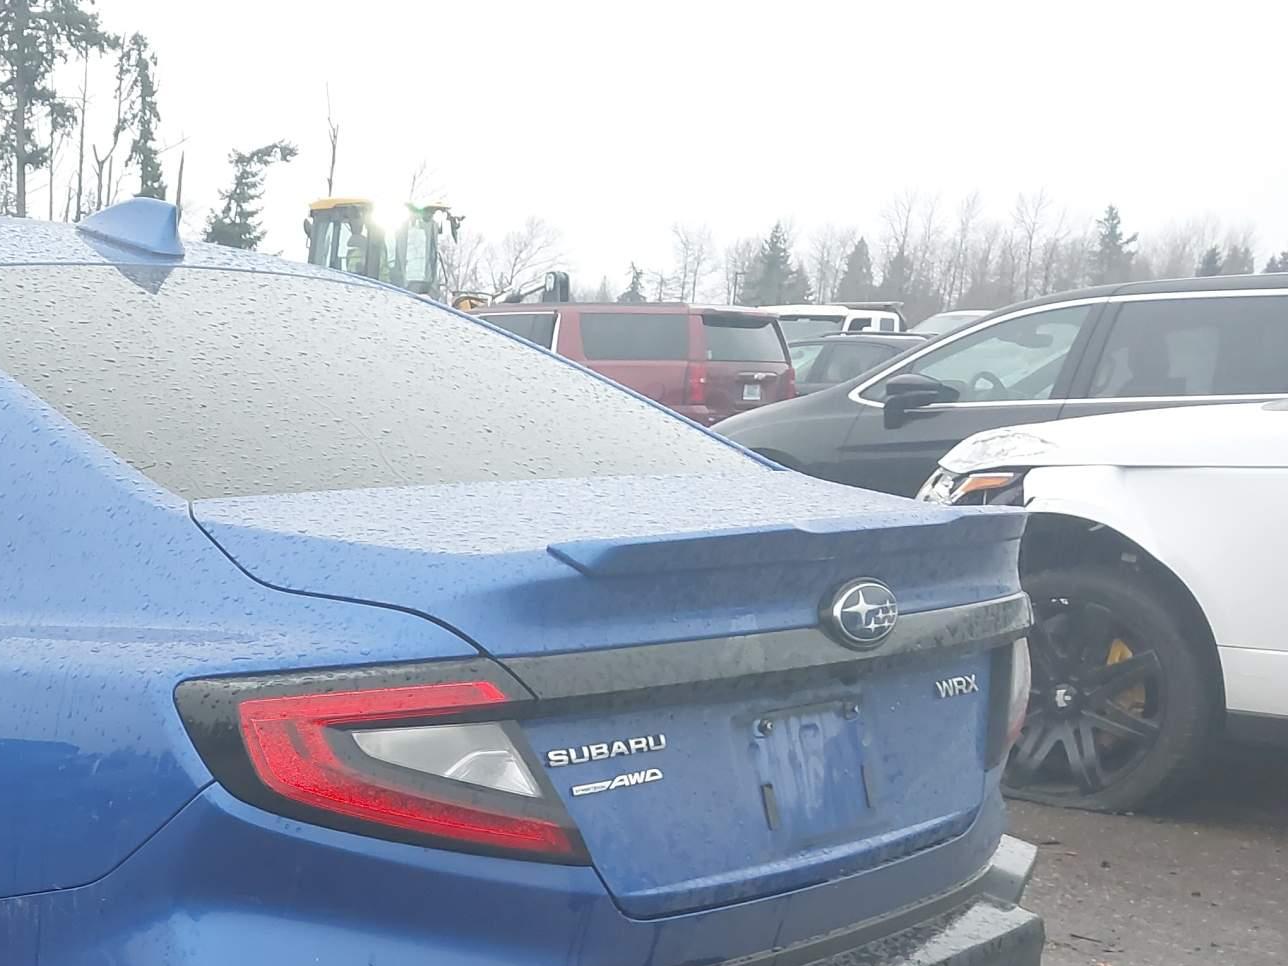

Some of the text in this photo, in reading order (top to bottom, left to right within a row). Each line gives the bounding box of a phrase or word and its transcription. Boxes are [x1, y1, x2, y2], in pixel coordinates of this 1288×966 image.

[935, 674, 979, 698] WRX
[546, 734, 666, 767] SUBARU
[610, 768, 664, 790] AWD
